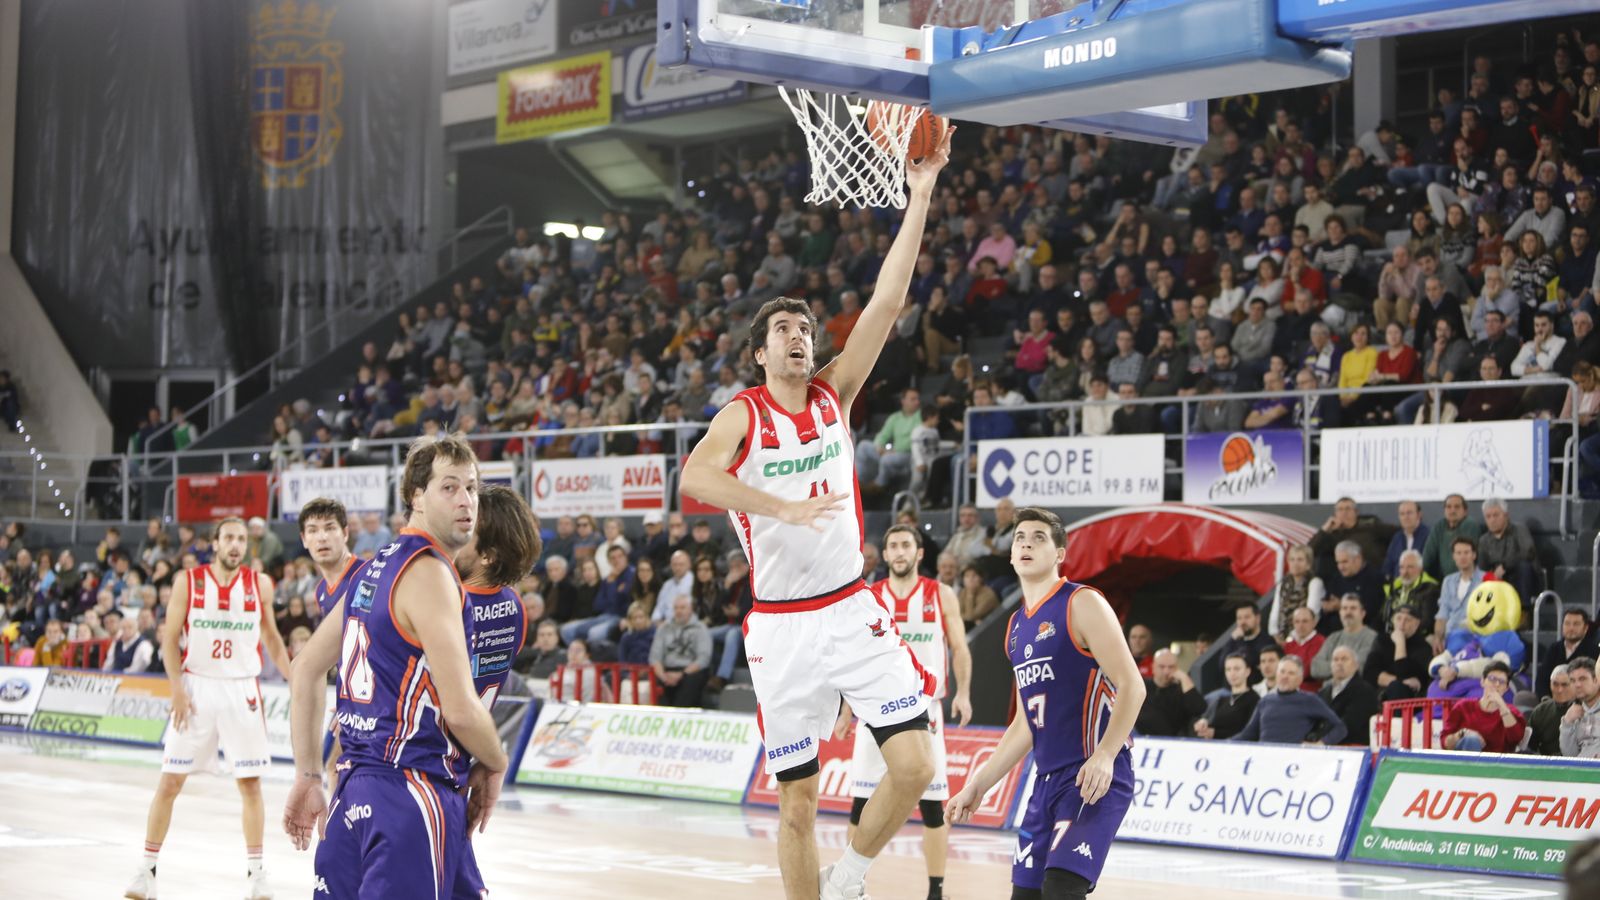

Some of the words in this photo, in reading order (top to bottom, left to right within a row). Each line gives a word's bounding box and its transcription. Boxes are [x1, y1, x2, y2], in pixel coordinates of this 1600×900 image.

[1044, 38, 1116, 68] MONDO
[1024, 449, 1092, 475] COPE
[554, 474, 613, 492] GASOPAL
[1022, 479, 1092, 496] PALENCIA
[1104, 478, 1132, 494] 99.8
[1139, 477, 1160, 494] FM
[193, 618, 254, 631] COVIRAN
[212, 639, 233, 659] 26
[880, 696, 917, 715] asisa
[607, 714, 663, 738] CALOR
[667, 719, 751, 745] NATURAL
[606, 740, 661, 757] CALDERAS
[663, 745, 678, 759] DE
[681, 747, 734, 762] BIOMASA
[768, 736, 812, 760] BERNER
[638, 761, 688, 779] PELLETS
[1132, 778, 1184, 810] REY
[1189, 783, 1334, 823] SANCHO
[1403, 789, 1498, 823] AUTO
[1122, 818, 1193, 837] ANQUETES
[1217, 826, 1325, 848] COMUNIONES
[1363, 835, 1379, 850] C/
[1473, 842, 1498, 860] Vial)
[1543, 849, 1566, 863] 979
